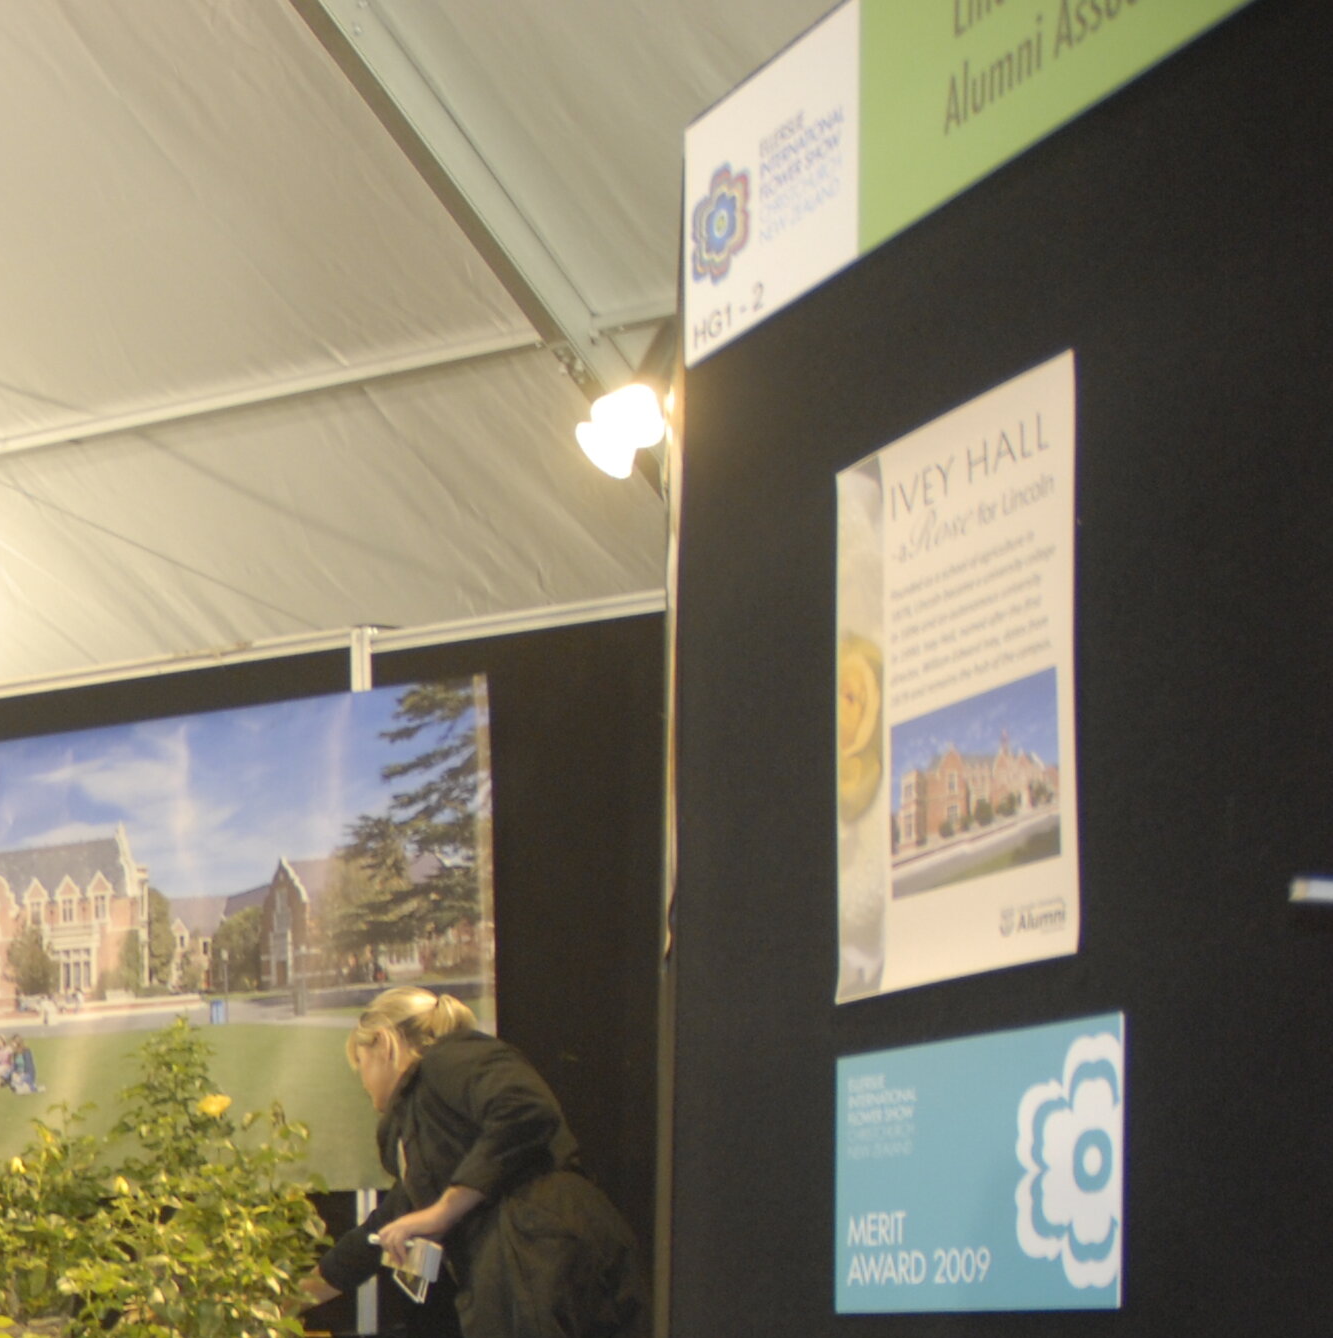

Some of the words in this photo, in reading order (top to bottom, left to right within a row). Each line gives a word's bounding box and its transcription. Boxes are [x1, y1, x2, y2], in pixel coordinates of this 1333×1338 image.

[944, 13, 1043, 136] Alumni
[693, 302, 733, 350] HG1
[753, 282, 765, 313] 2
[890, 454, 955, 521] IVEY
[967, 411, 1050, 484] HALL
[1001, 472, 1055, 517] Lincoln
[1015, 908, 1065, 933] Alumni
[847, 1210, 907, 1247] MERIT
[847, 1249, 927, 1287] AWARD
[934, 1245, 992, 1285] 2009
